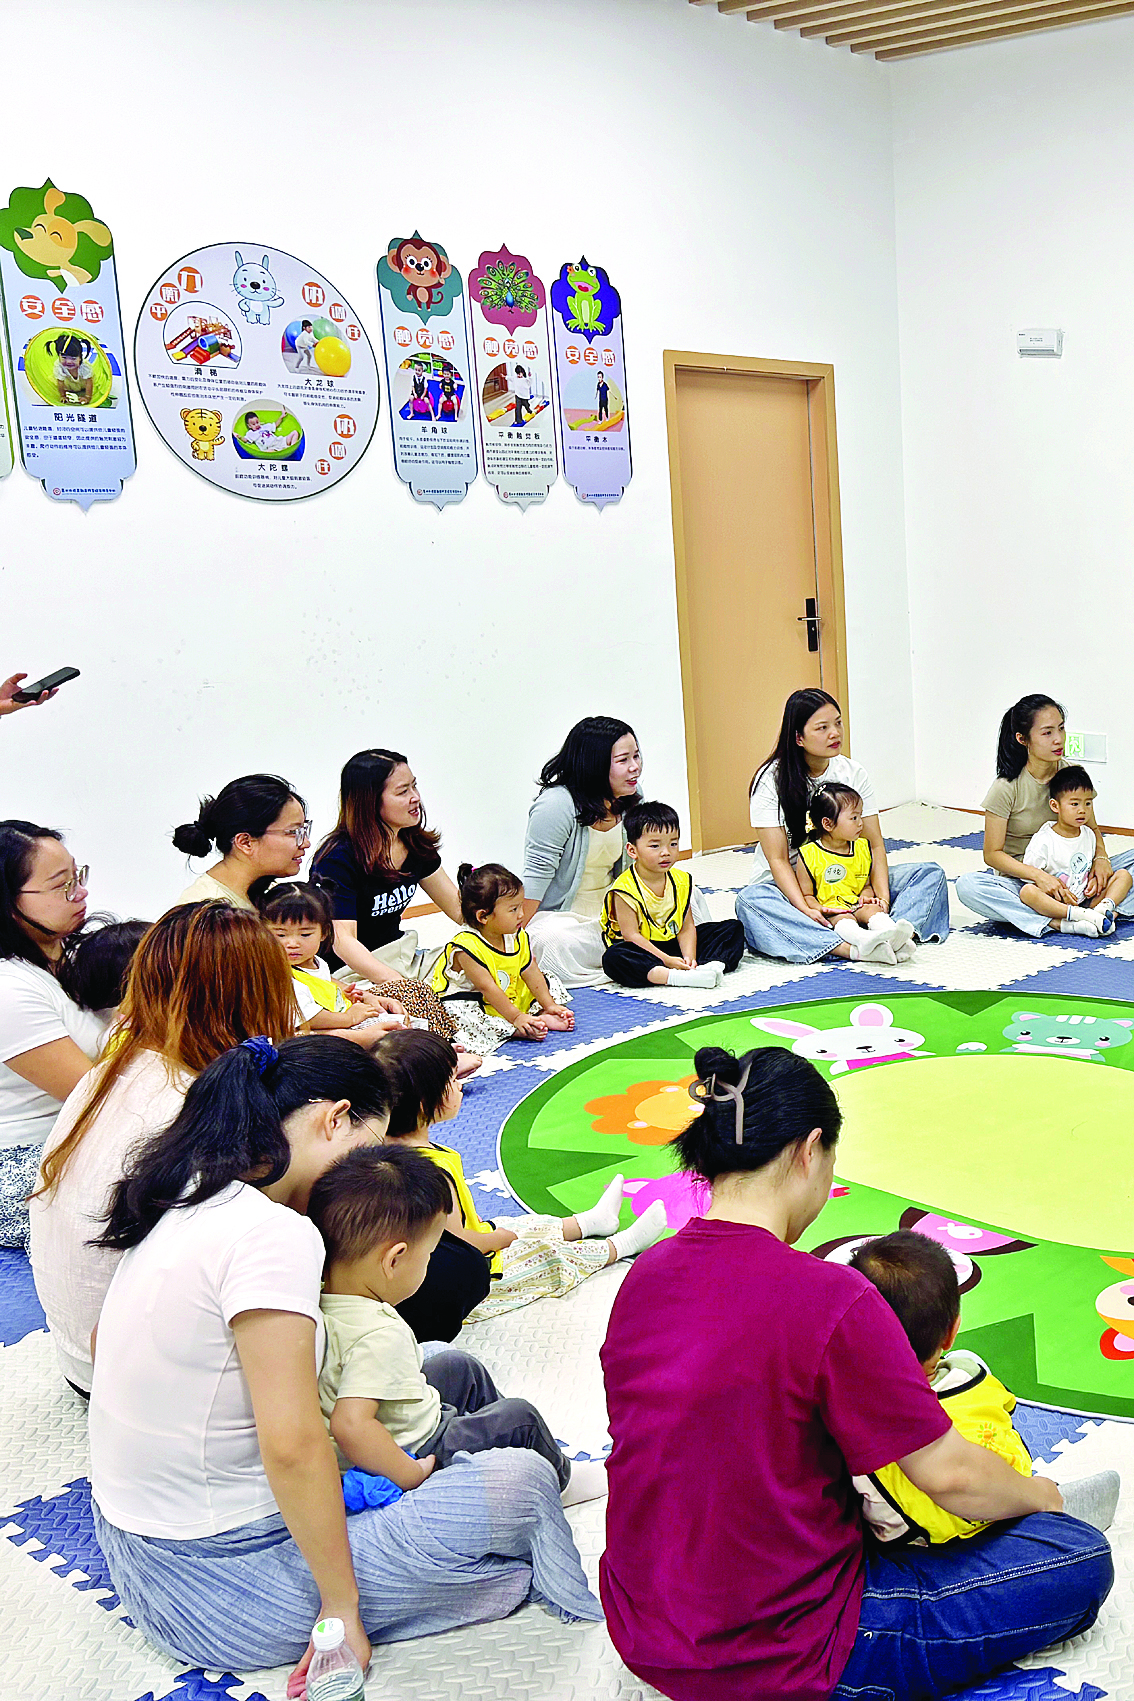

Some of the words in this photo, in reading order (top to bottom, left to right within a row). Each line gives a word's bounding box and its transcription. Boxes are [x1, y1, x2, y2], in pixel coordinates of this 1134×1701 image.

[20, 297, 104, 322] 安全感
[393, 327, 455, 349] 触觉感
[483, 338, 539, 359] 触觉感
[565, 347, 617, 366] 安全感
[53, 412, 98, 423] 阳光隧道
[371, 884, 416, 911] Hello
